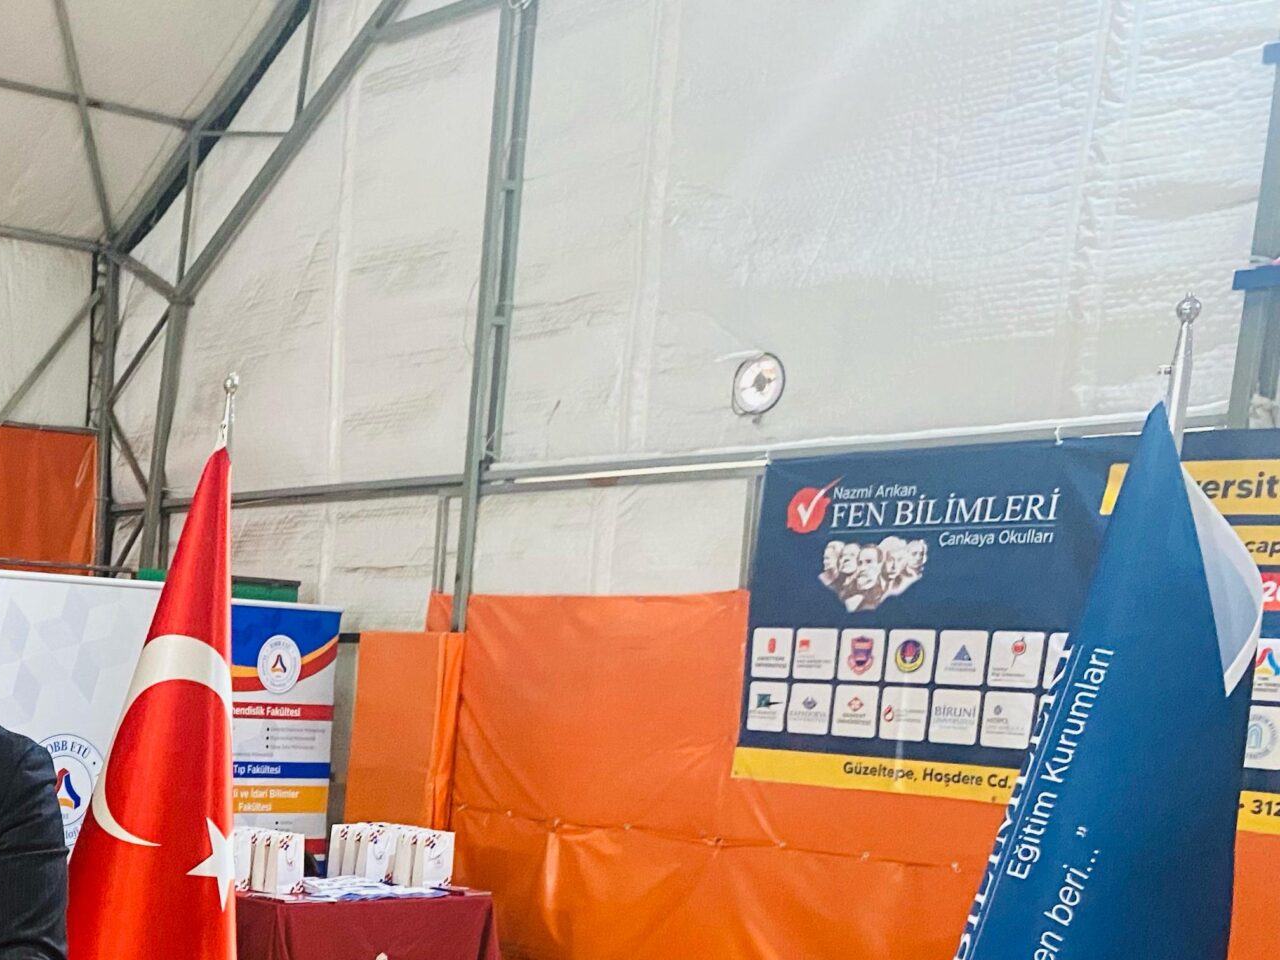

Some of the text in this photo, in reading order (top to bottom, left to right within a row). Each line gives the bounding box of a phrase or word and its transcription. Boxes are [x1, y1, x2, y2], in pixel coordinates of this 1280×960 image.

[832, 487, 872, 500] Nazmi
[830, 487, 1061, 528] FEN BİLİMLERİ
[938, 530, 1054, 547] Çankaya Okulları
[266, 706, 301, 717] Fakültesi
[247, 764, 281, 775] Fakültesi
[1006, 791, 1059, 880] Eğitim
[1040, 647, 1115, 784] Kurumları
[843, 761, 917, 782] Güzeltepe,
[922, 767, 984, 788] Hoşdere
[986, 773, 1013, 789] Cd.
